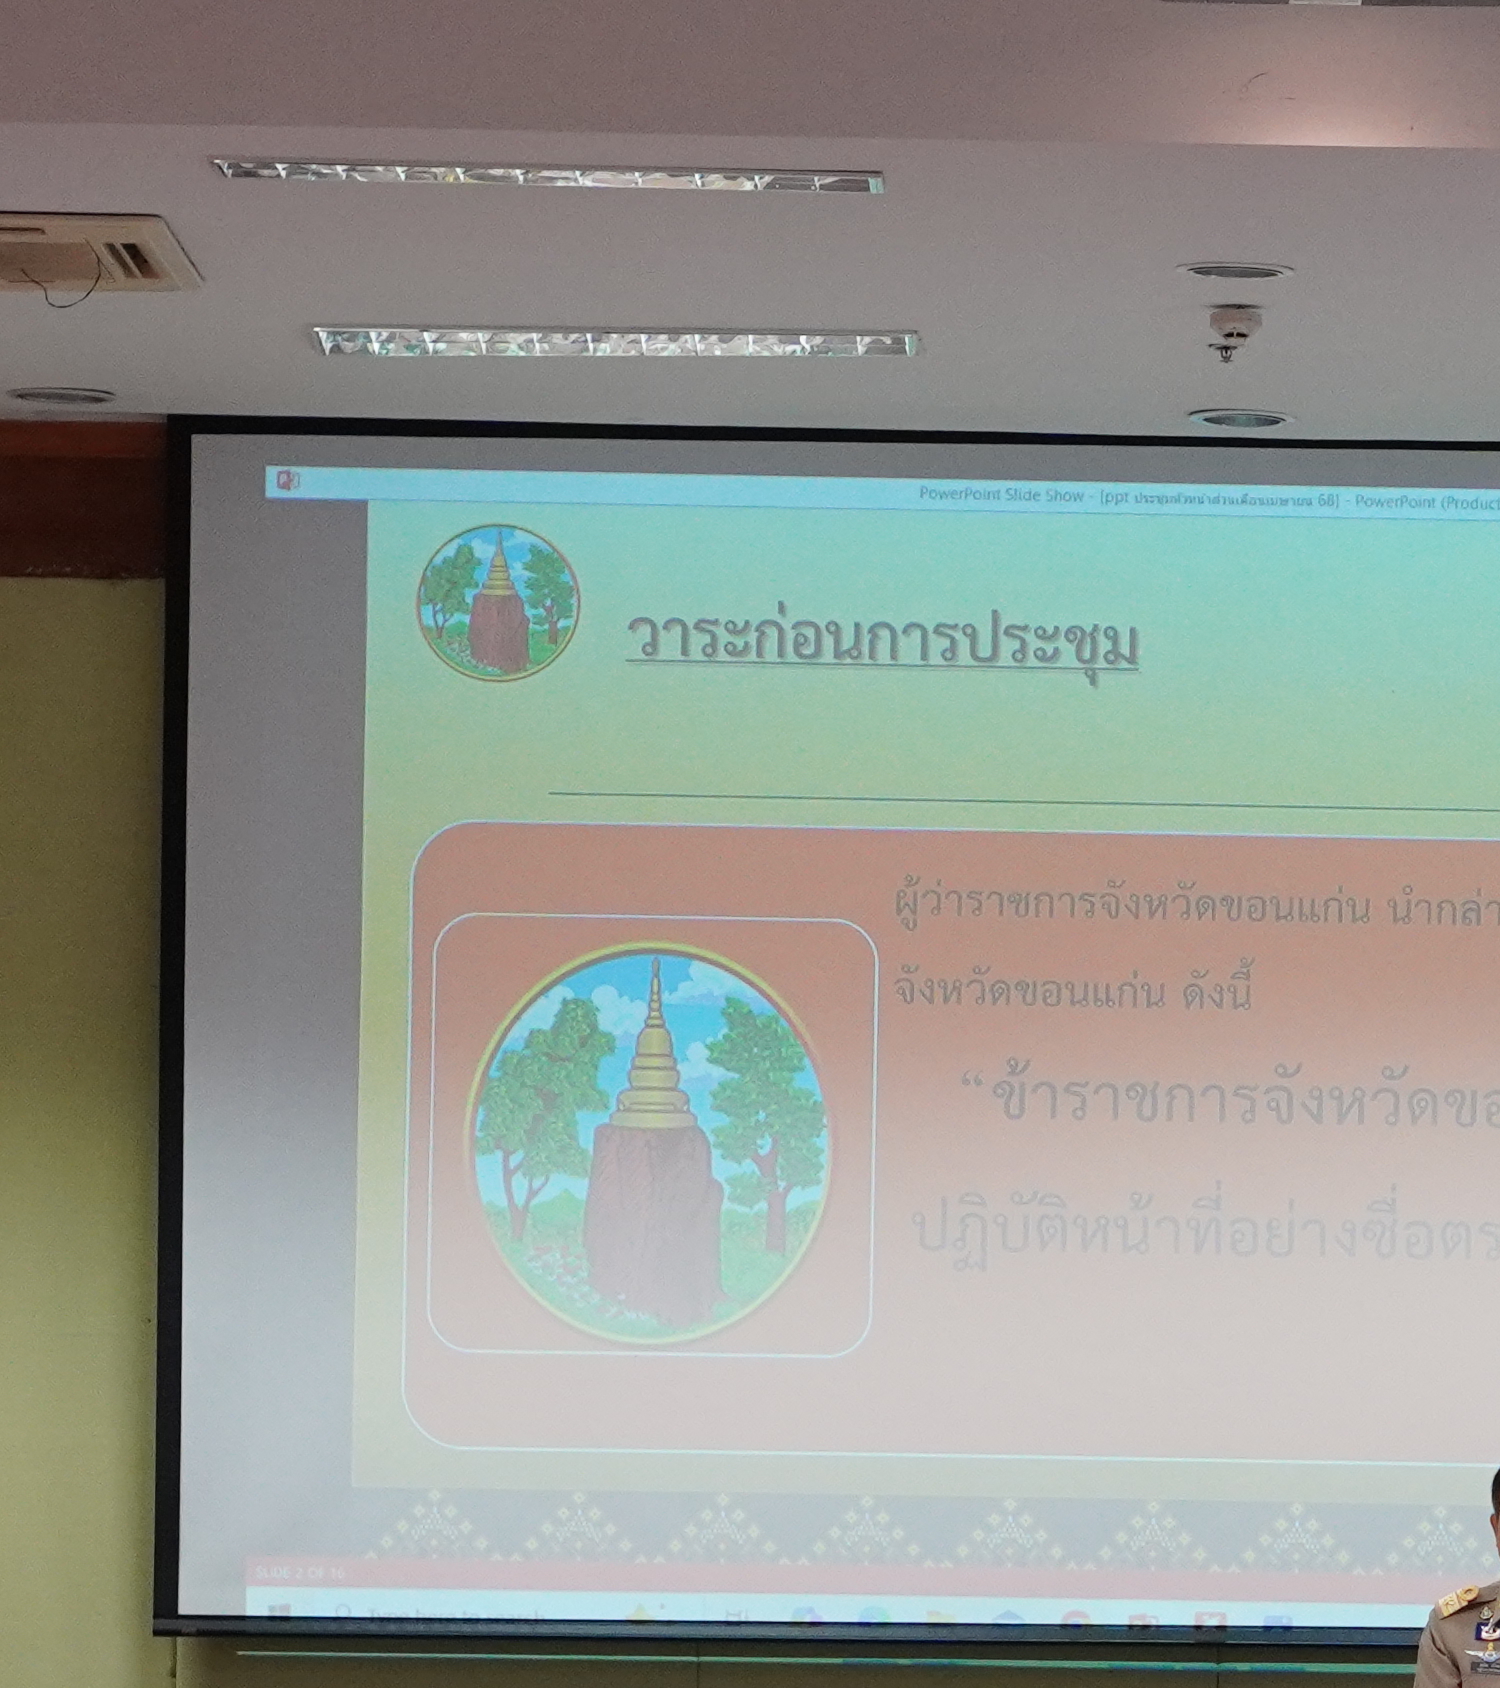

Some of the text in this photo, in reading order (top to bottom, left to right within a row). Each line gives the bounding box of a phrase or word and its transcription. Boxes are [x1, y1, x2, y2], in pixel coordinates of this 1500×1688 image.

[920, 485, 1000, 502] PowerPoint
[1005, 486, 1041, 502] Slide
[1046, 487, 1084, 503] Show
[1356, 493, 1436, 510] PowerPoint
[1440, 494, 1500, 513] (Product
[626, 602, 1140, 688] วาระก่อนการประชุม
[894, 873, 1369, 933] ผู้ว่าราชการจังหวัดขอนแก่น
[893, 957, 1257, 1012] จังหวัดขอนแก่น ดังนี้
